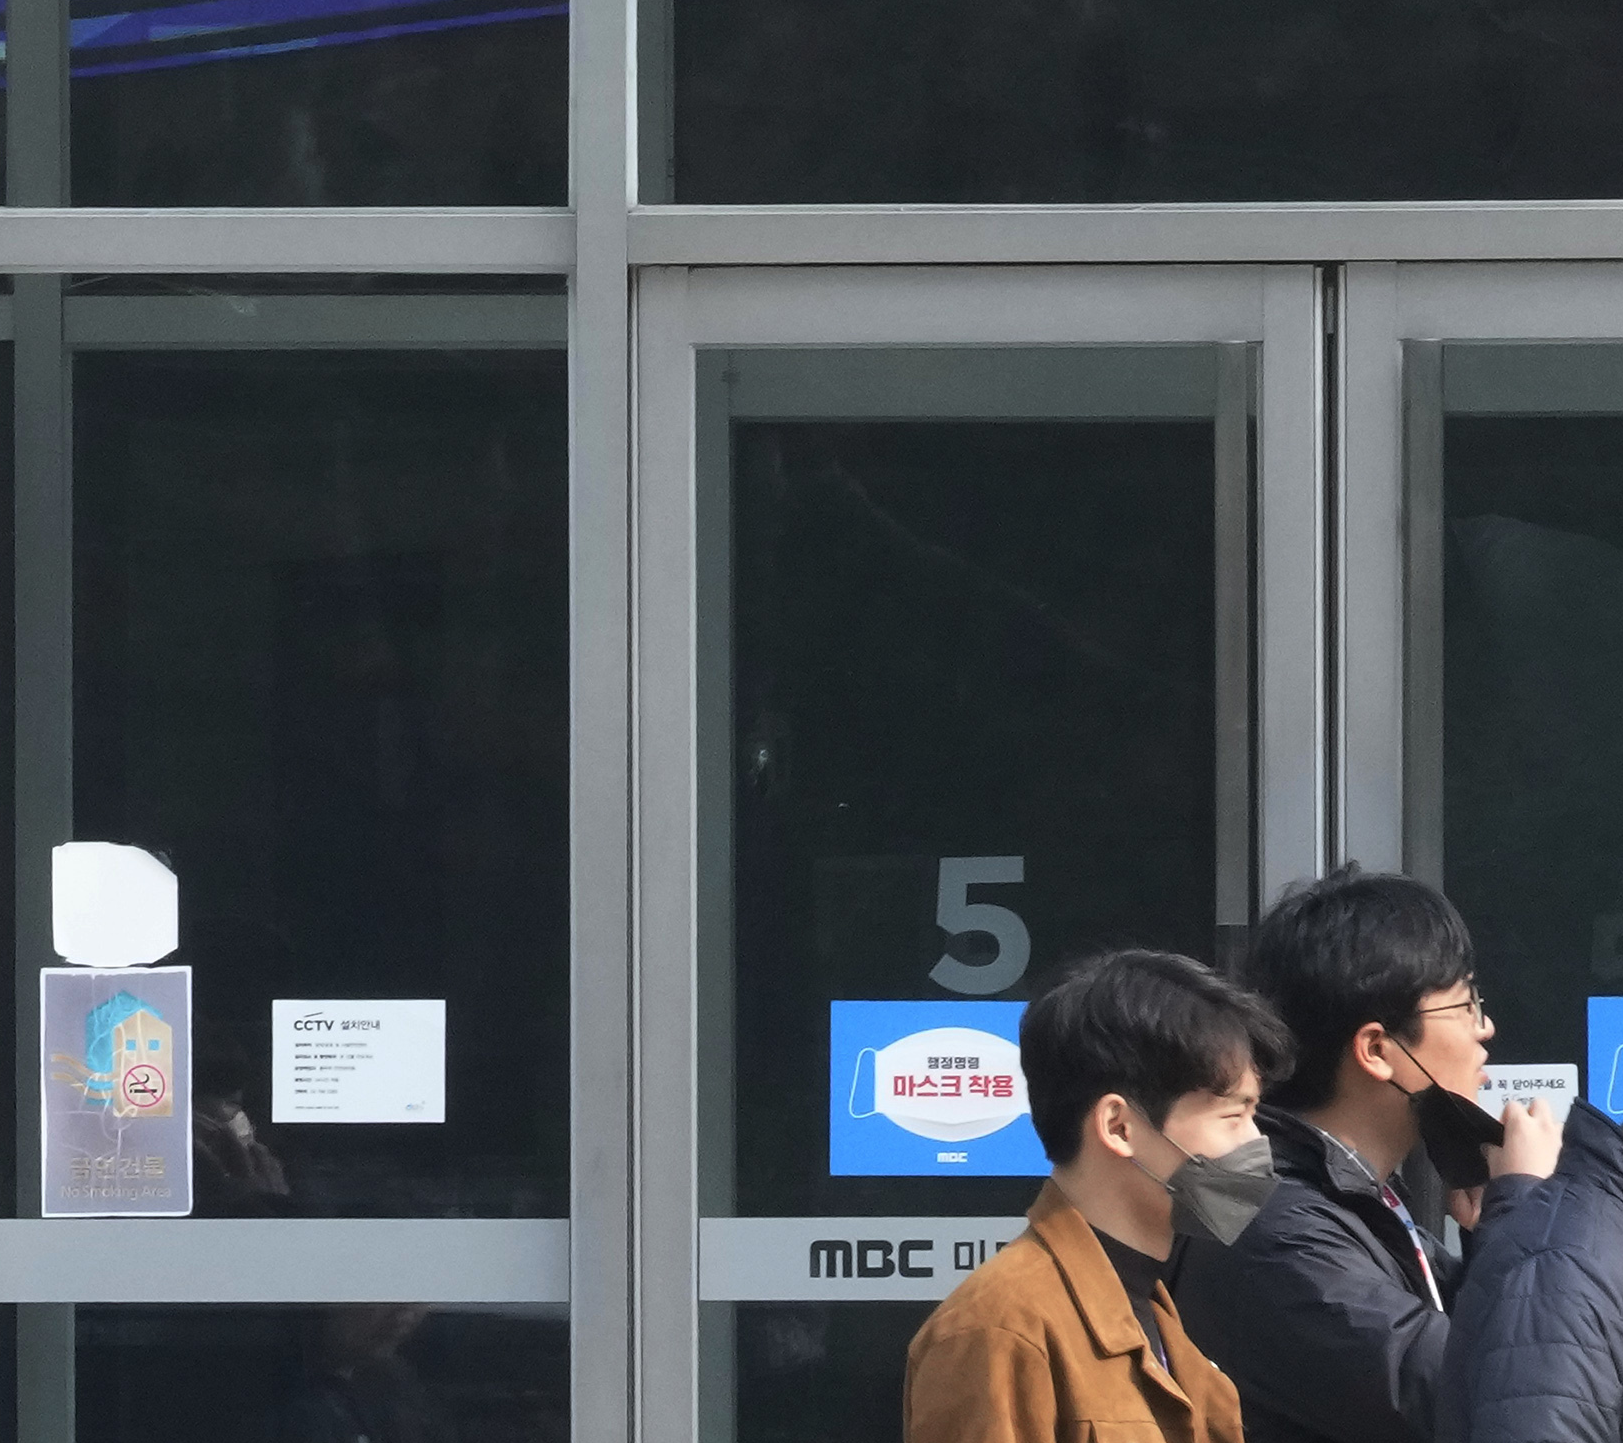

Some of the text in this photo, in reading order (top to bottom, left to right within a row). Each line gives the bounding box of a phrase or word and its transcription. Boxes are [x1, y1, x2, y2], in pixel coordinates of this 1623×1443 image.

[928, 855, 1031, 995] 5
[294, 1019, 381, 1032] CCTV 설치안내
[927, 1056, 980, 1070] 행정명령
[893, 1074, 1014, 1098] 마스크 착용
[1512, 1077, 1566, 1091] 닫아주세요
[936, 1151, 969, 1164] MBC
[61, 1186, 80, 1199] No
[142, 1186, 172, 1199] Area
[810, 1239, 934, 1278] MBC
